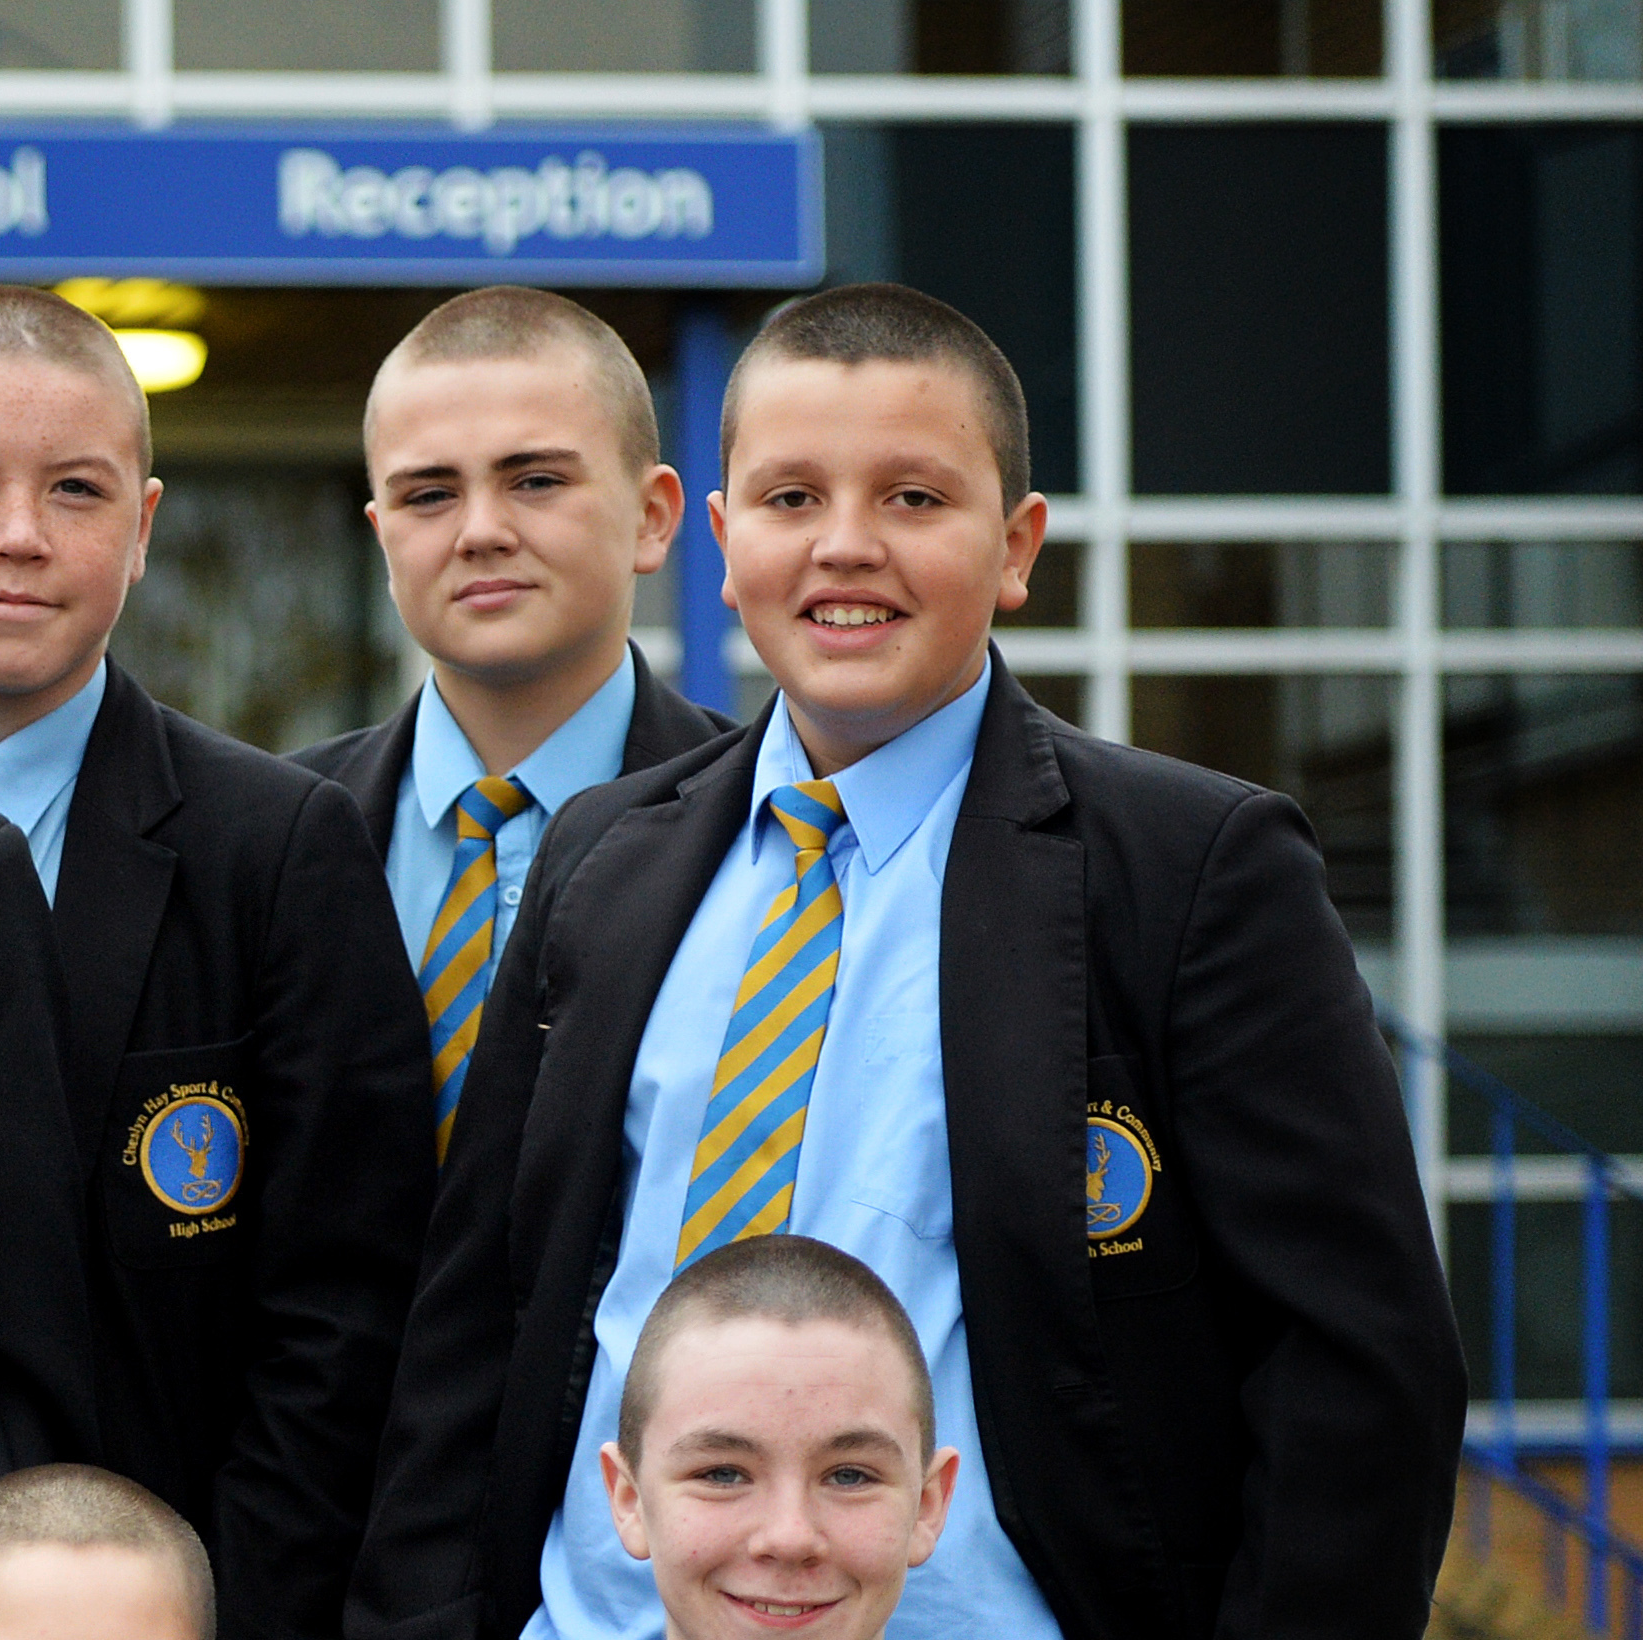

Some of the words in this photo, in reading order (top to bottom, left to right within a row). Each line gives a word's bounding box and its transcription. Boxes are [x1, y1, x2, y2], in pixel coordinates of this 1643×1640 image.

[277, 147, 714, 256] Reception
[122, 1114, 148, 1166] Cheslyn
[143, 1092, 169, 1114] Hay
[170, 1082, 207, 1099] Sport
[208, 1080, 219, 1095] &
[1100, 1100, 1113, 1115] &
[1116, 1106, 1162, 1172] Community
[169, 1221, 199, 1238] High
[201, 1214, 237, 1232] School
[1099, 1237, 1143, 1257] School
